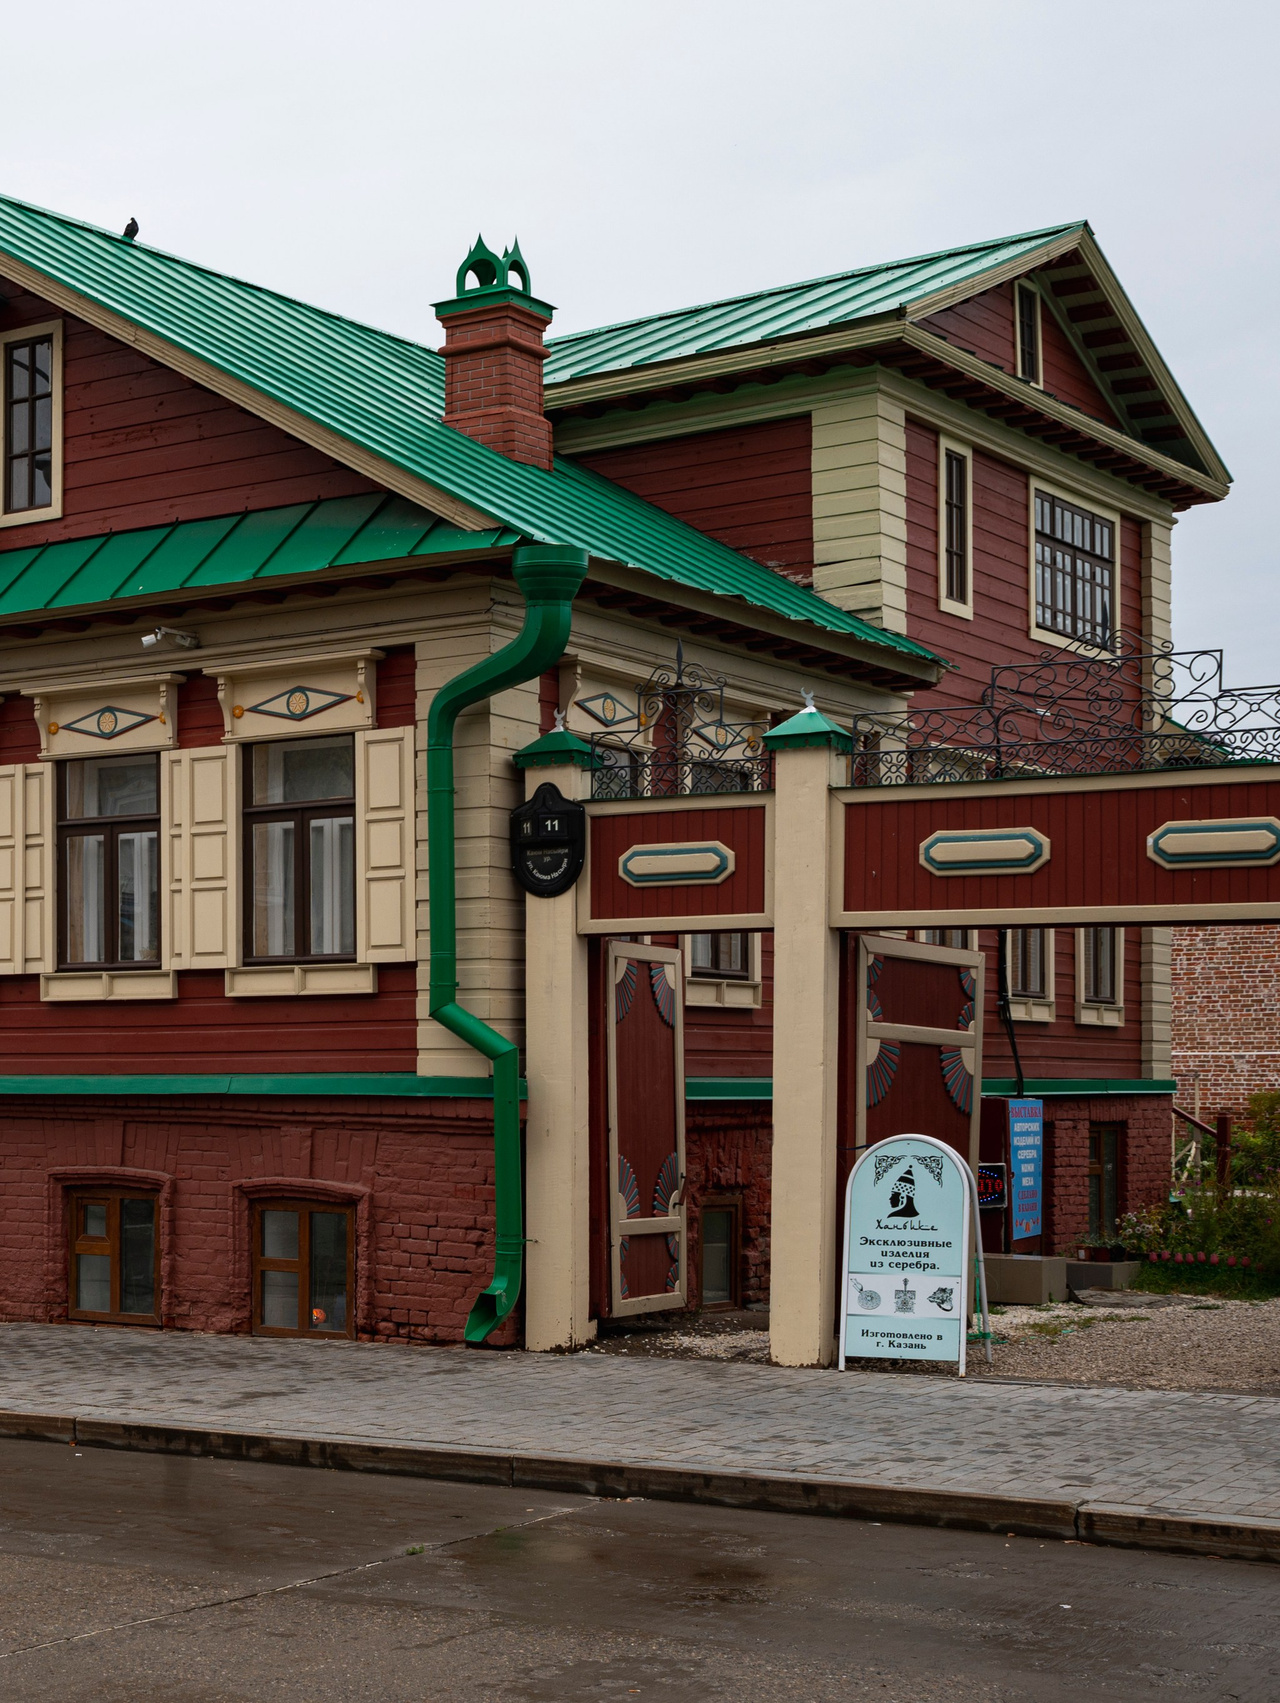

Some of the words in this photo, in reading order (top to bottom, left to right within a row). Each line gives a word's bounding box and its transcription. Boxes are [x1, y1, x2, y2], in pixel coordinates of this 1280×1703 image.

[523, 822, 530, 834] 11
[545, 819, 559, 831] 11
[1011, 1106, 1042, 1118] ВЫСТАВКА
[1014, 1122, 1040, 1132] АВТОРСКИХ
[1013, 1133, 1034, 1147] ИЗДЕЛИЙ
[1034, 1136, 1040, 1145] ИЗ
[1017, 1149, 1037, 1159] СЕРЕБРА
[859, 1236, 953, 1248] Эксклюзивные
[881, 1250, 930, 1259] изделия
[888, 1261, 940, 1272] серебра.
[861, 1329, 933, 1341] Изготовлено
[888, 1340, 927, 1350] Казань
